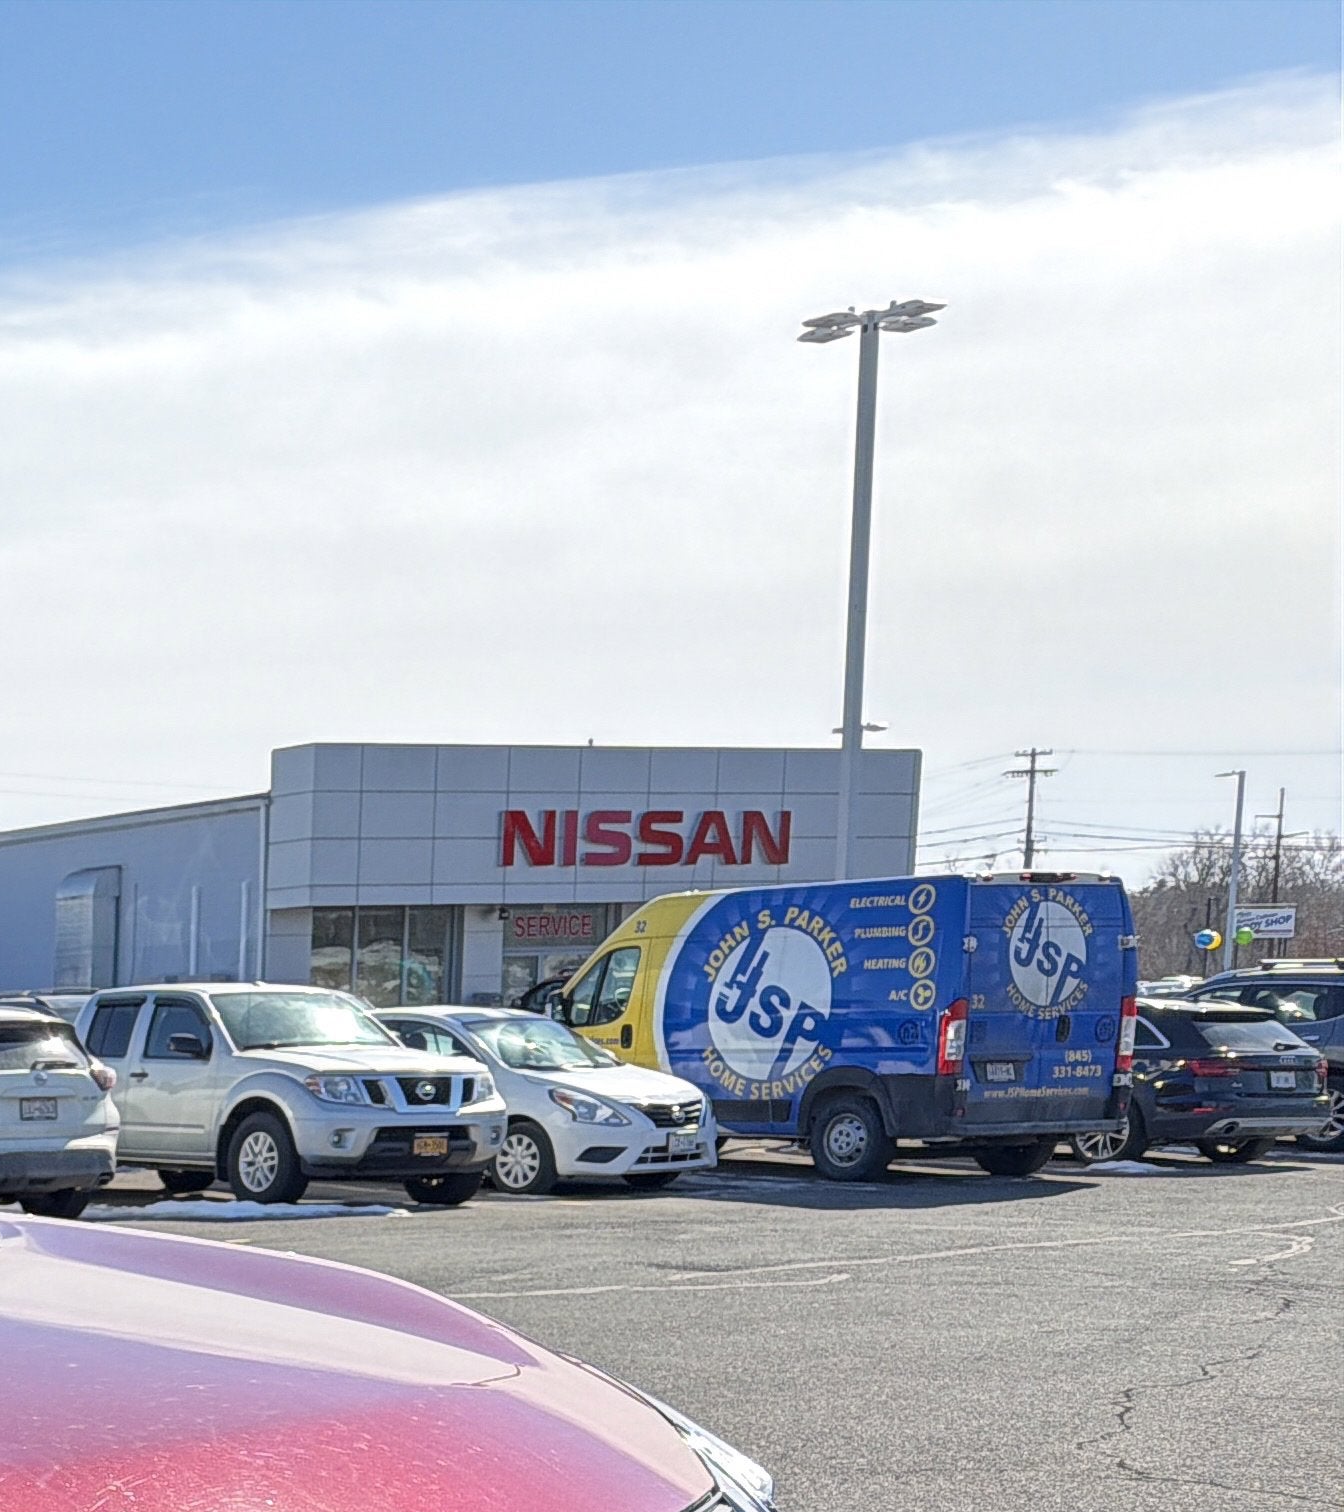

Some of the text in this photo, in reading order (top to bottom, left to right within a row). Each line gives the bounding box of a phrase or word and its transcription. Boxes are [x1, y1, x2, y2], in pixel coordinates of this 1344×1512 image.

[500, 810, 791, 866] NISSAN
[849, 895, 906, 909] ELECTRICAL
[1002, 887, 1093, 938] JOHN S. PARKER
[515, 915, 593, 938] SERVICE
[634, 920, 647, 934] 32
[1265, 915, 1292, 927] SHOP
[854, 928, 906, 940] PLUMBING
[704, 907, 847, 982] JOHN S. PARKER
[864, 958, 906, 970] HEATING
[889, 990, 908, 1001] A/C
[1006, 980, 1089, 1020] HOME SERVICES
[1065, 1049, 1093, 1064] (845)
[702, 1044, 832, 1099] HOME SERVICES
